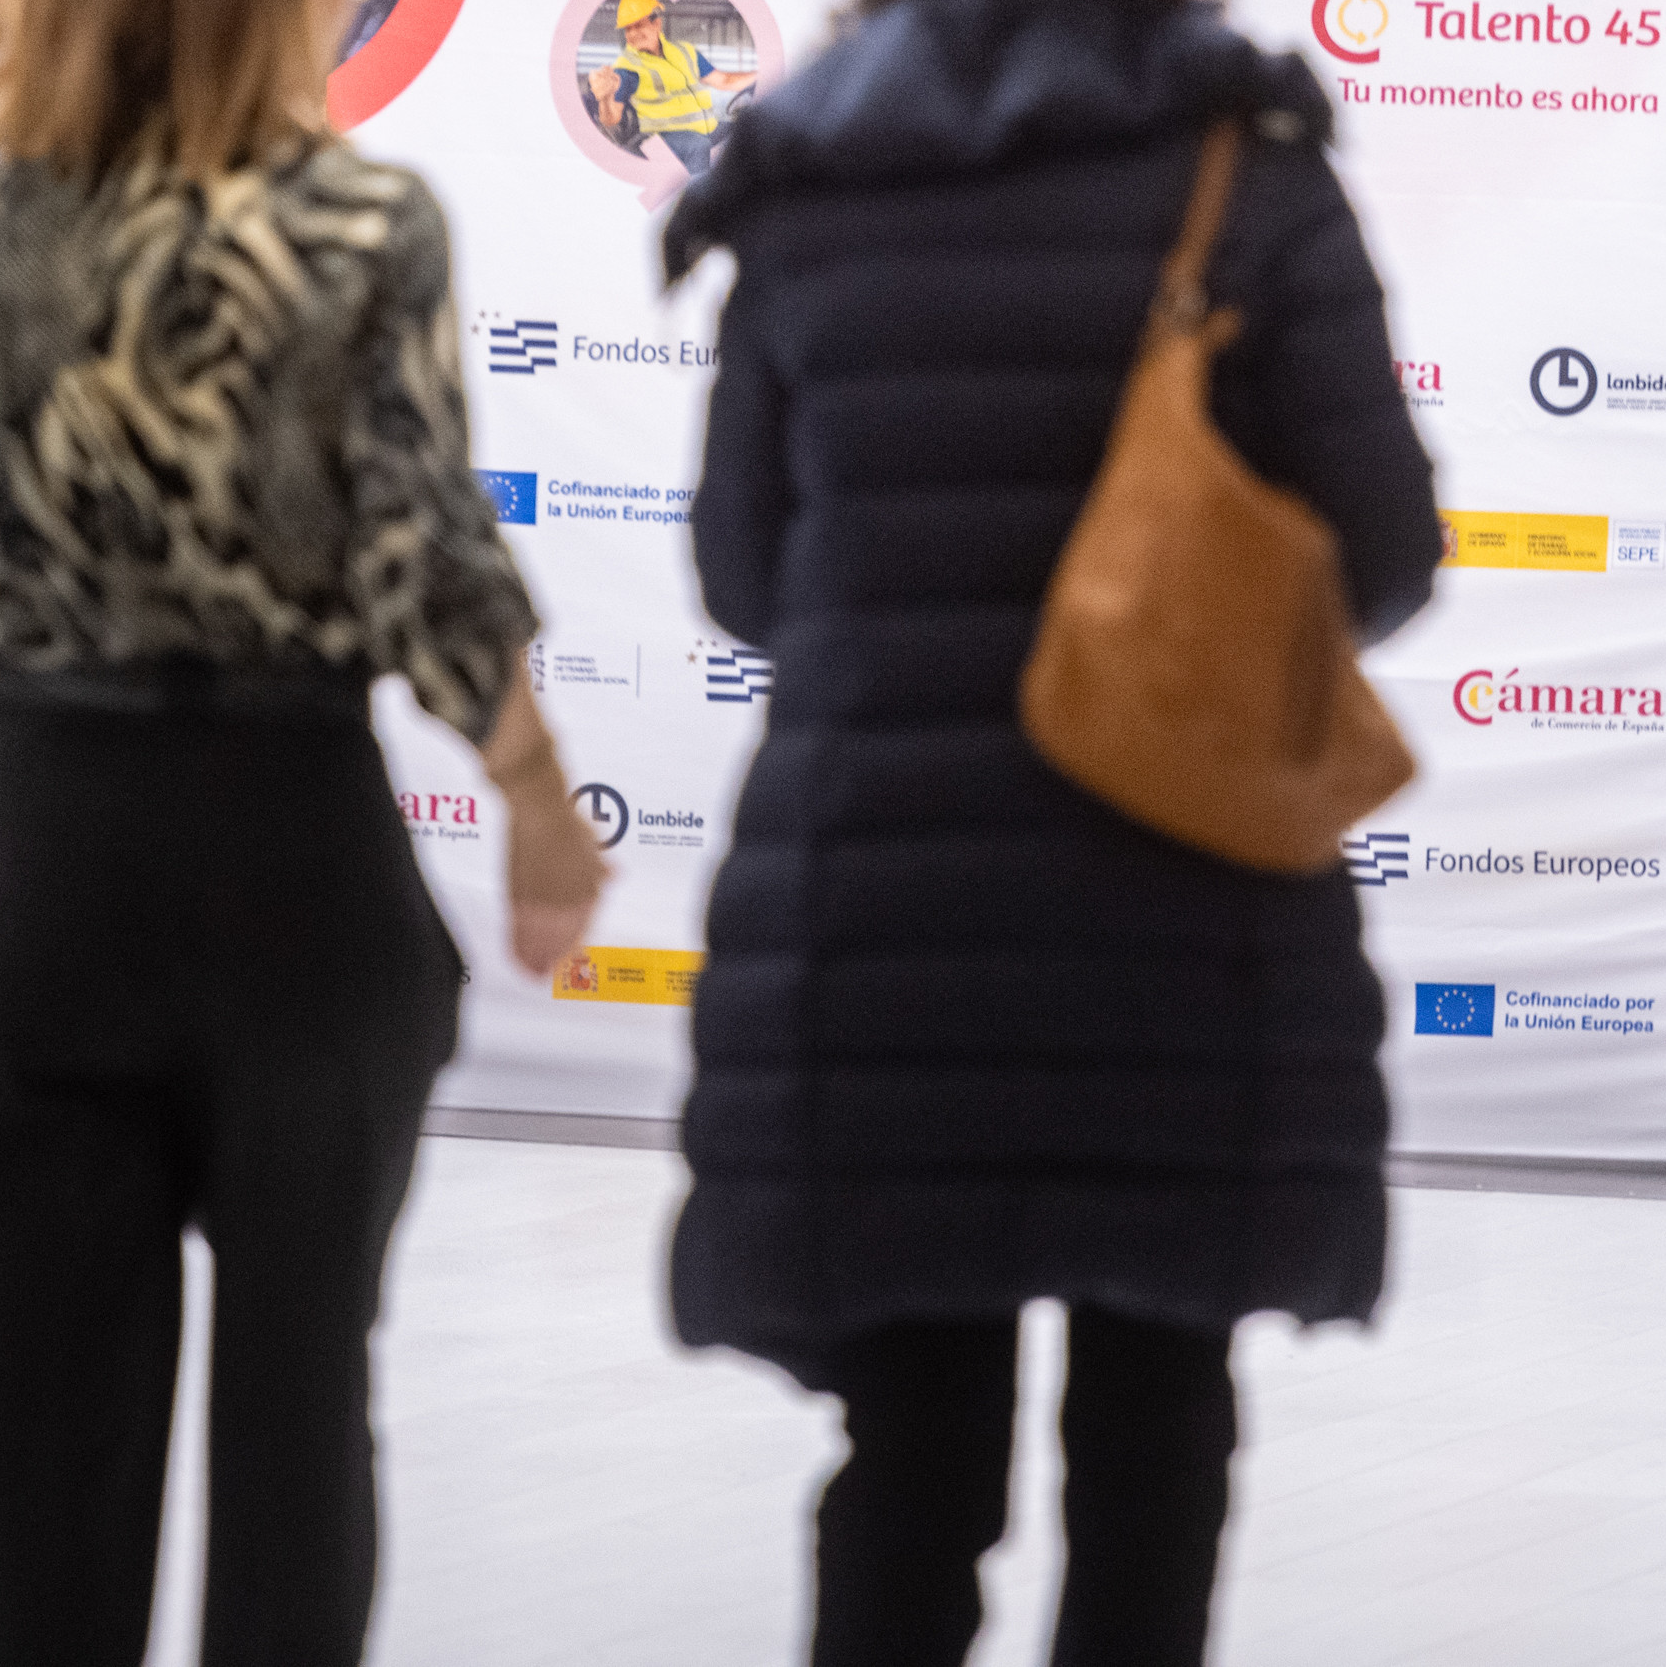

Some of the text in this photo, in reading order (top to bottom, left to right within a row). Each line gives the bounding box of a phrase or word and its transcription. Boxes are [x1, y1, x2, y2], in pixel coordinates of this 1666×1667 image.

[1414, 0, 1591, 44] Talento
[1337, 77, 1659, 114] Tu momento es ahora
[572, 335, 671, 365] Fondos
[547, 479, 661, 501] Cofinanciado
[547, 502, 563, 518] la
[566, 502, 618, 521] Unión
[1617, 545, 1660, 563] SEPE
[399, 790, 479, 825] ara
[637, 807, 705, 830] lanbide
[1424, 847, 1661, 883] Fondos Europeos
[1505, 989, 1655, 1015] Cofinanciado por
[1504, 1012, 1655, 1034] la Unión Europea
